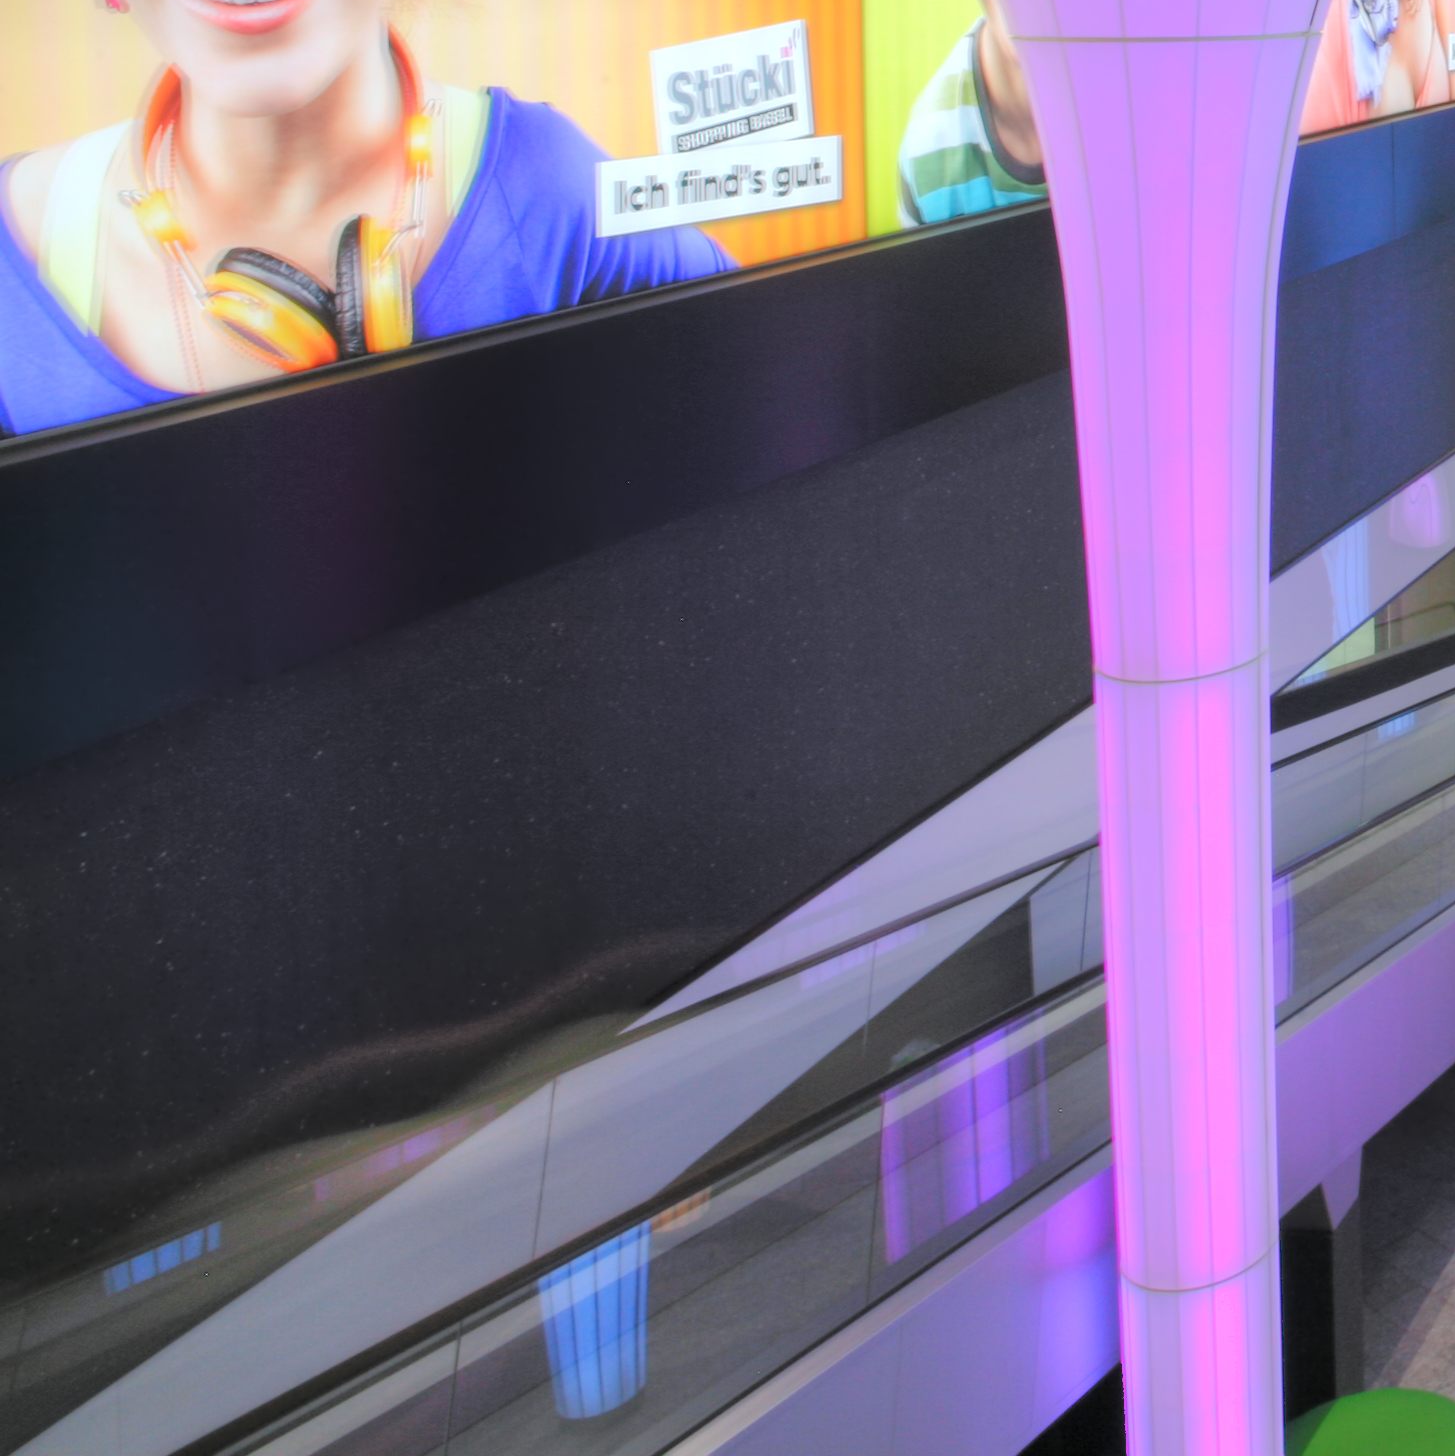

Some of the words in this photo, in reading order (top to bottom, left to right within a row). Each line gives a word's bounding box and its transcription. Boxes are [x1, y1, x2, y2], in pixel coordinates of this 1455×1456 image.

[665, 45, 797, 126] Stücki
[614, 175, 669, 215] Ich
[675, 164, 767, 205] find's
[772, 156, 832, 197] gut.
